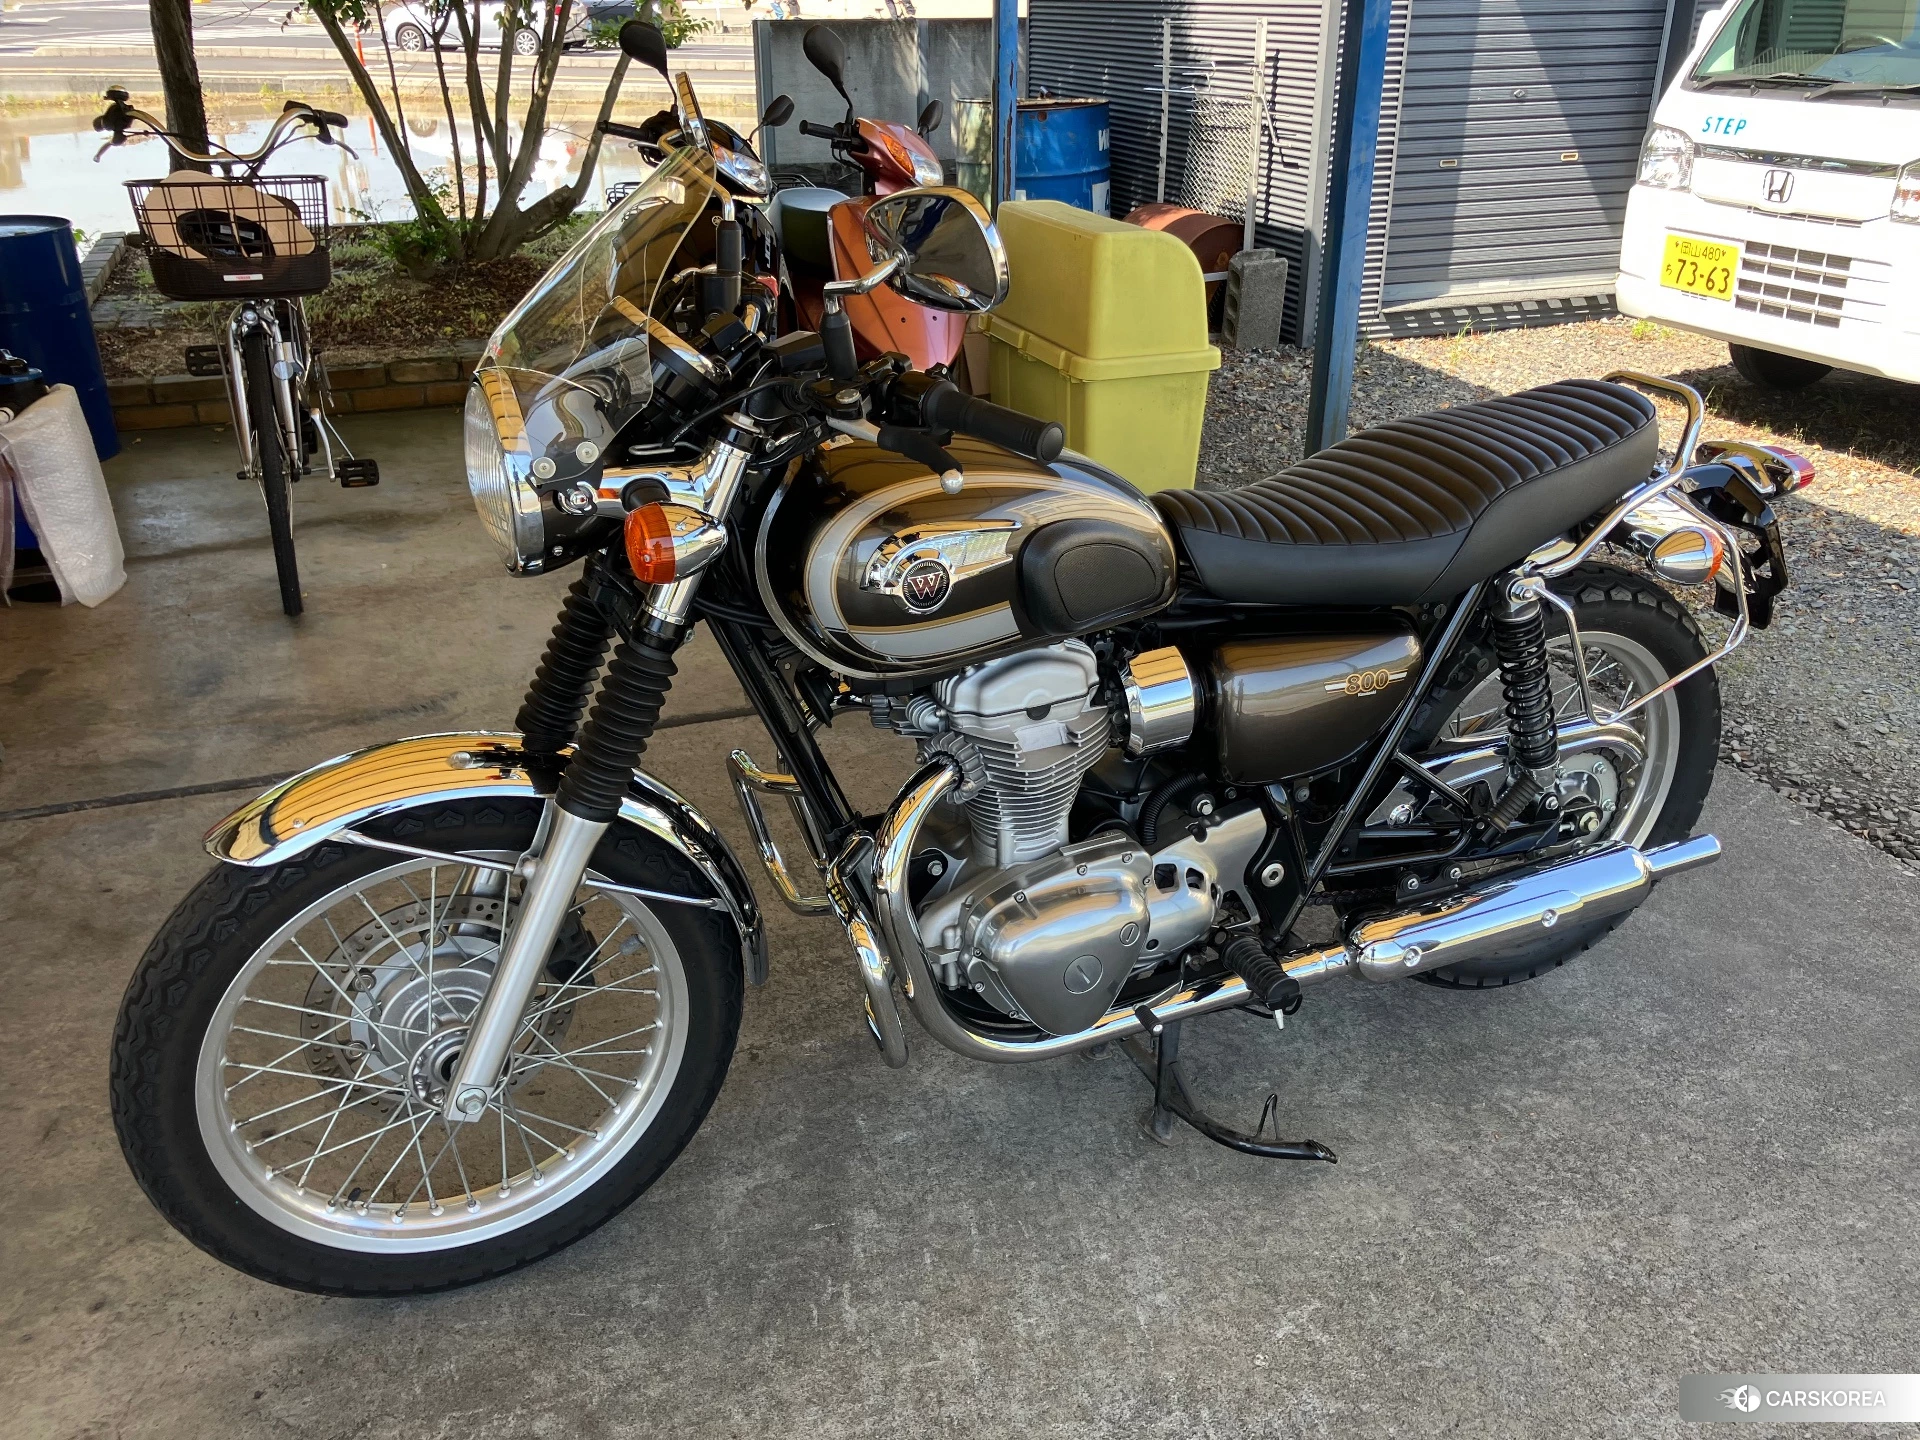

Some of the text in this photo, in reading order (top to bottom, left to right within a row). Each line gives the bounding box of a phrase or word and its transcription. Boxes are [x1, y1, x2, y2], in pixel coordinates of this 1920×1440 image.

[1702, 116, 1747, 136] STEP
[1675, 258, 1731, 294] 73-63
[907, 571, 944, 600] W
[1344, 668, 1391, 695] 800
